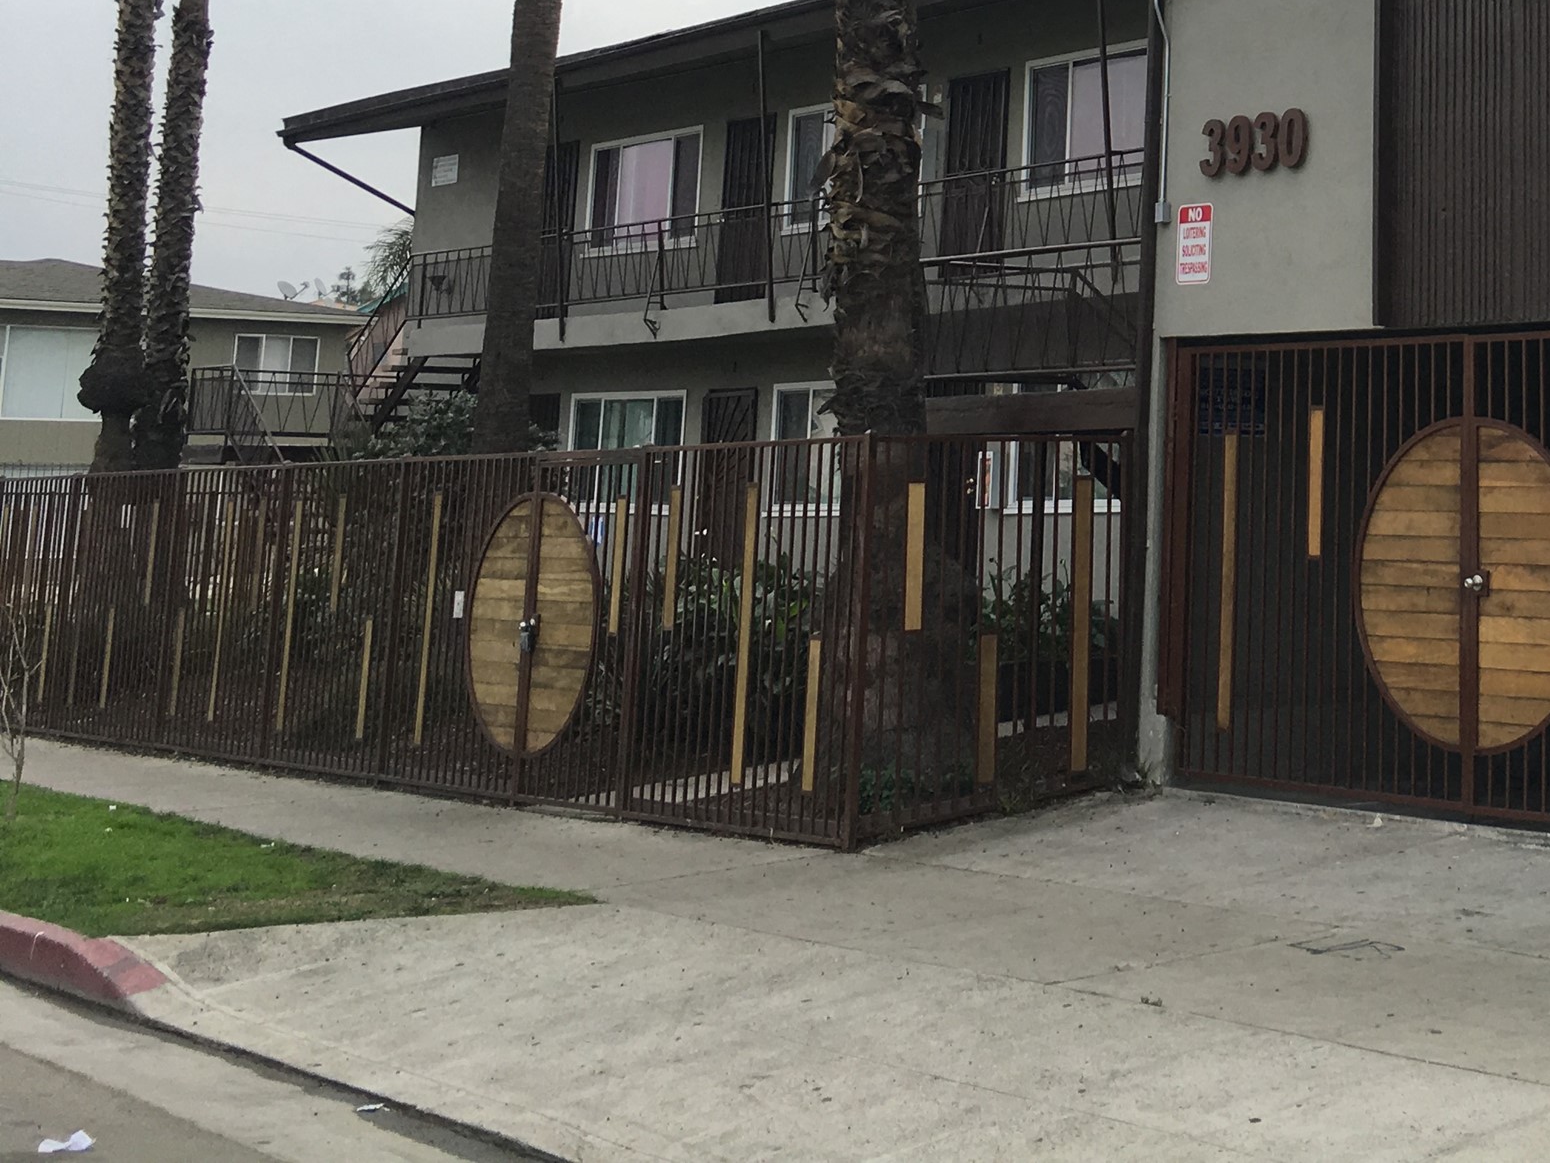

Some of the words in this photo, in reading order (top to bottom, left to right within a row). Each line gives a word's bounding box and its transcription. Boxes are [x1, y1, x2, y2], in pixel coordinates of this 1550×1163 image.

[1199, 108, 1307, 177] 3930
[1188, 207, 1203, 222] NO
[1183, 226, 1206, 240] LOITERING
[1182, 244, 1206, 257] SOLICITING
